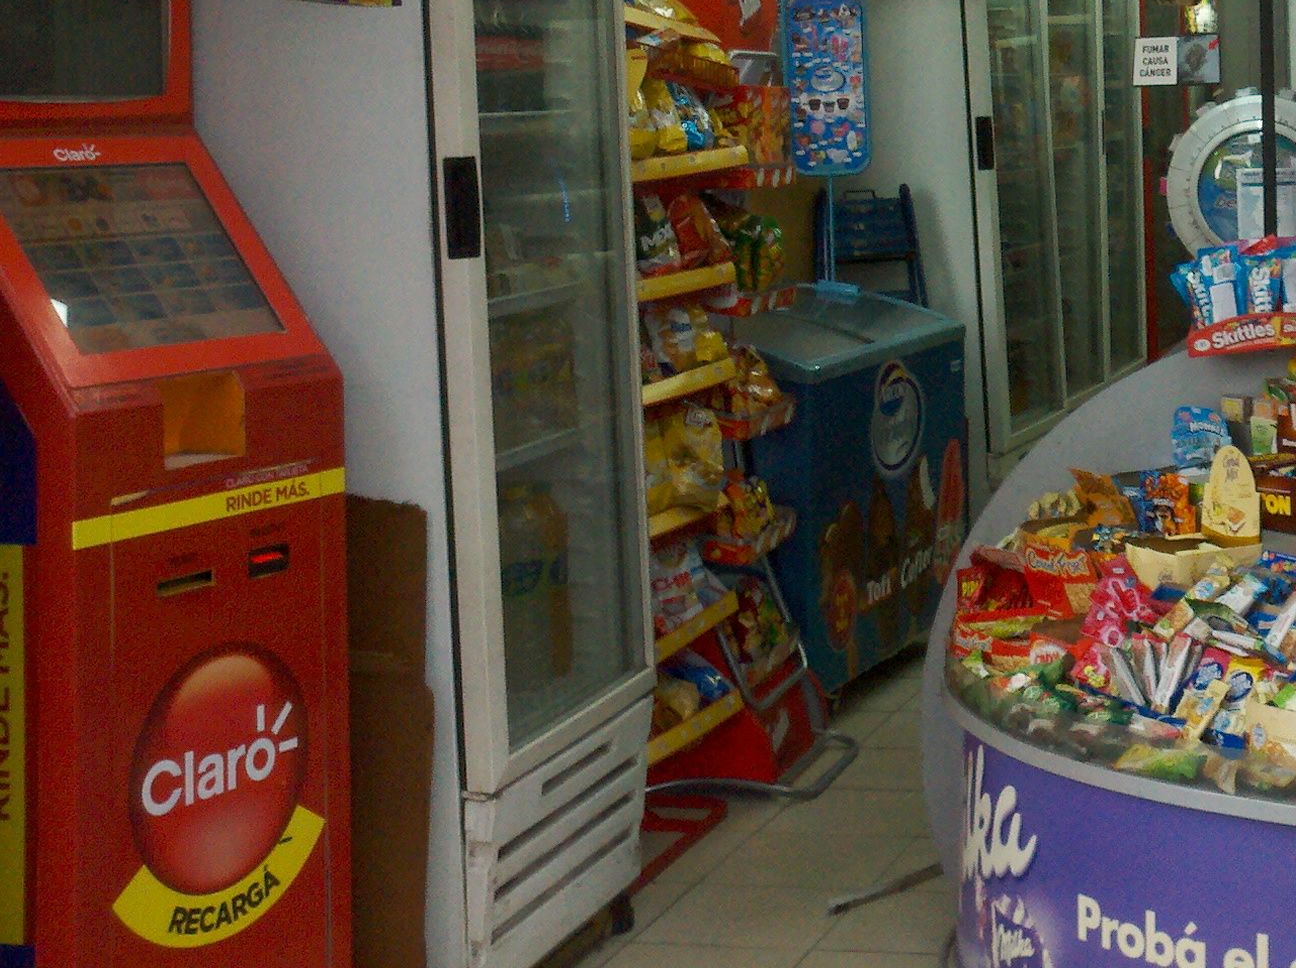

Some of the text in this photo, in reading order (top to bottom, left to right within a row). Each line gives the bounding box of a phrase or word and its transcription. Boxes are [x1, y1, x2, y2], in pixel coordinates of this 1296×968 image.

[1142, 45, 1170, 54] FUMAR
[1142, 57, 1169, 65] CAUSA
[53, 144, 101, 162] Claro
[1211, 323, 1276, 349] Skittles
[225, 480, 311, 513] RINDE MÁS.
[141, 700, 299, 817] Claro
[168, 864, 283, 936] RECARGÁ
[1077, 893, 1206, 968] Probá
